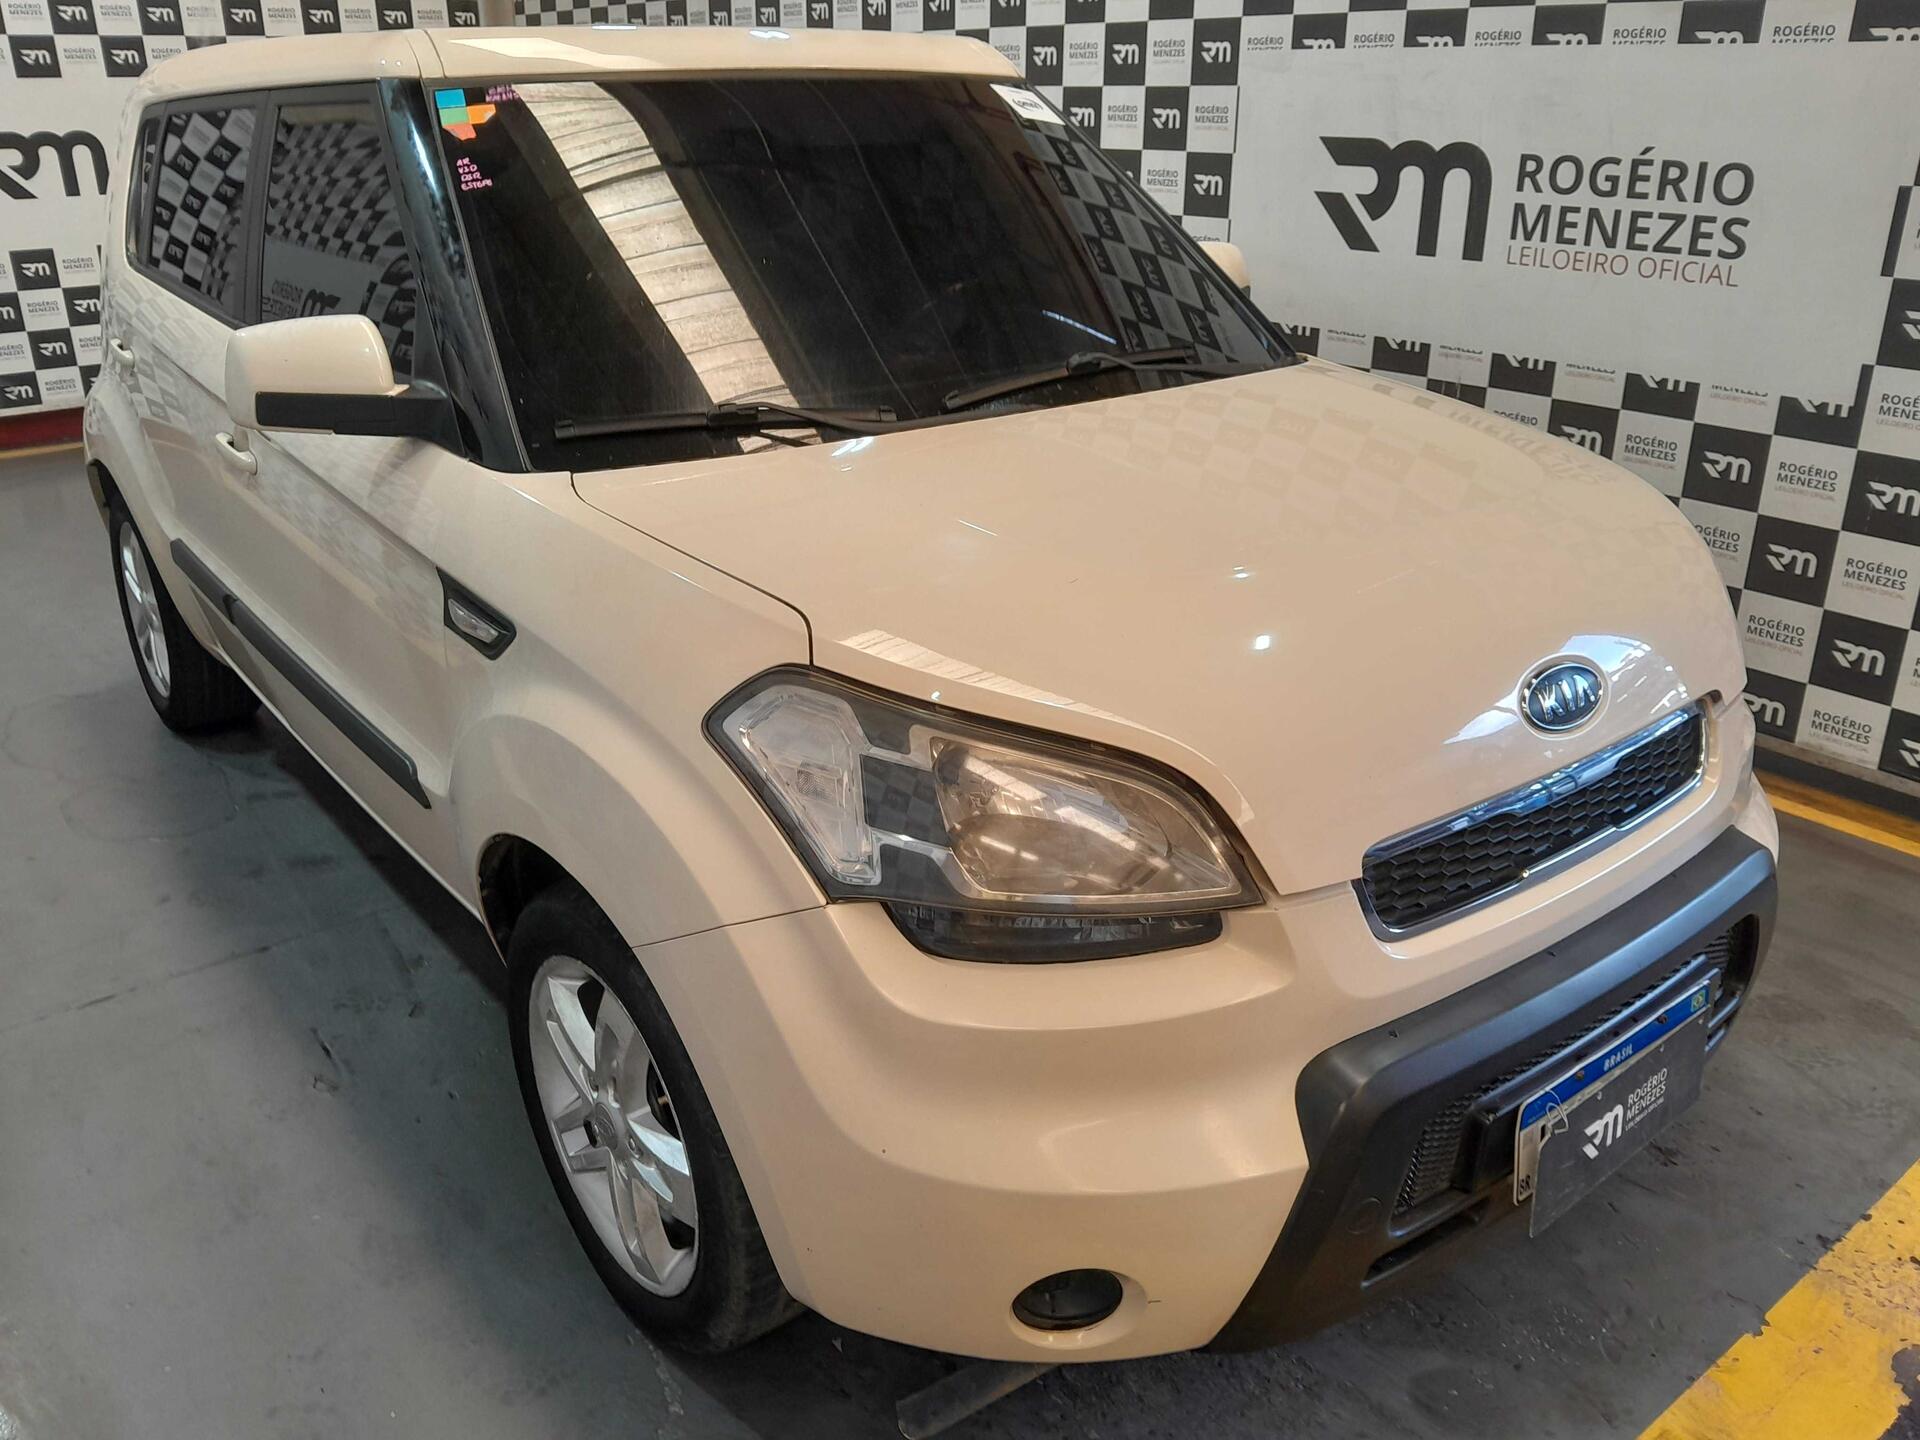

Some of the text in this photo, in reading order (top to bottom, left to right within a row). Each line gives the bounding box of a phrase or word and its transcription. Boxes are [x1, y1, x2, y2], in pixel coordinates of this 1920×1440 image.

[1353, 30, 1395, 44] ROGÉRIO
[1474, 27, 1522, 41] ROGÉRIO
[1613, 25, 1667, 39] ROGÉRIO
[1773, 22, 1836, 38] ROGÉRIO
[1069, 40, 1099, 50] ROGÉRIO
[1153, 38, 1186, 49] ROGÉRIO
[1248, 33, 1284, 46] ROGÉRIO
[1069, 50, 1099, 60] MENEZES
[1152, 48, 1186, 58] MENEZES
[1107, 104, 1138, 113] ROGÉRIO
[1195, 104, 1229, 115] ROGÉRIO
[1107, 113, 1138, 122] MENEZES
[1194, 114, 1229, 124] MENEZES
[1146, 168, 1178, 178] ROGÉRIO
[1515, 146, 1755, 206] ROGÉRIO
[1146, 178, 1178, 188] MENEZES
[1509, 202, 1751, 260] MENEZES
[1506, 244, 1740, 288] LEILOEIRO OFICIAL
[1881, 392, 1920, 409] ROGÉ
[1878, 405, 1920, 421] MENE
[1626, 434, 1678, 451] ROGÉRIO
[1624, 444, 1677, 462] MENEZES
[1778, 461, 1838, 481] ROGÉRIO
[1776, 472, 1838, 492] MENEZES
[1695, 524, 1740, 542] OGÉRIO
[1846, 558, 1908, 579] ROGÉRIO
[1843, 568, 1907, 591] MENEZES
[1748, 614, 1805, 636] ROGÉRIO
[1746, 625, 1804, 648] MENEZES
[1534, 674, 1596, 721] KIA
[1813, 709, 1872, 734] ROGÉRIO
[1810, 720, 1871, 745] MENEZES
[1604, 1043, 1633, 1072] BRASIL
[1628, 1068, 1668, 1108] ROGÉRIO
[1626, 1080, 1667, 1122] MENEZES
